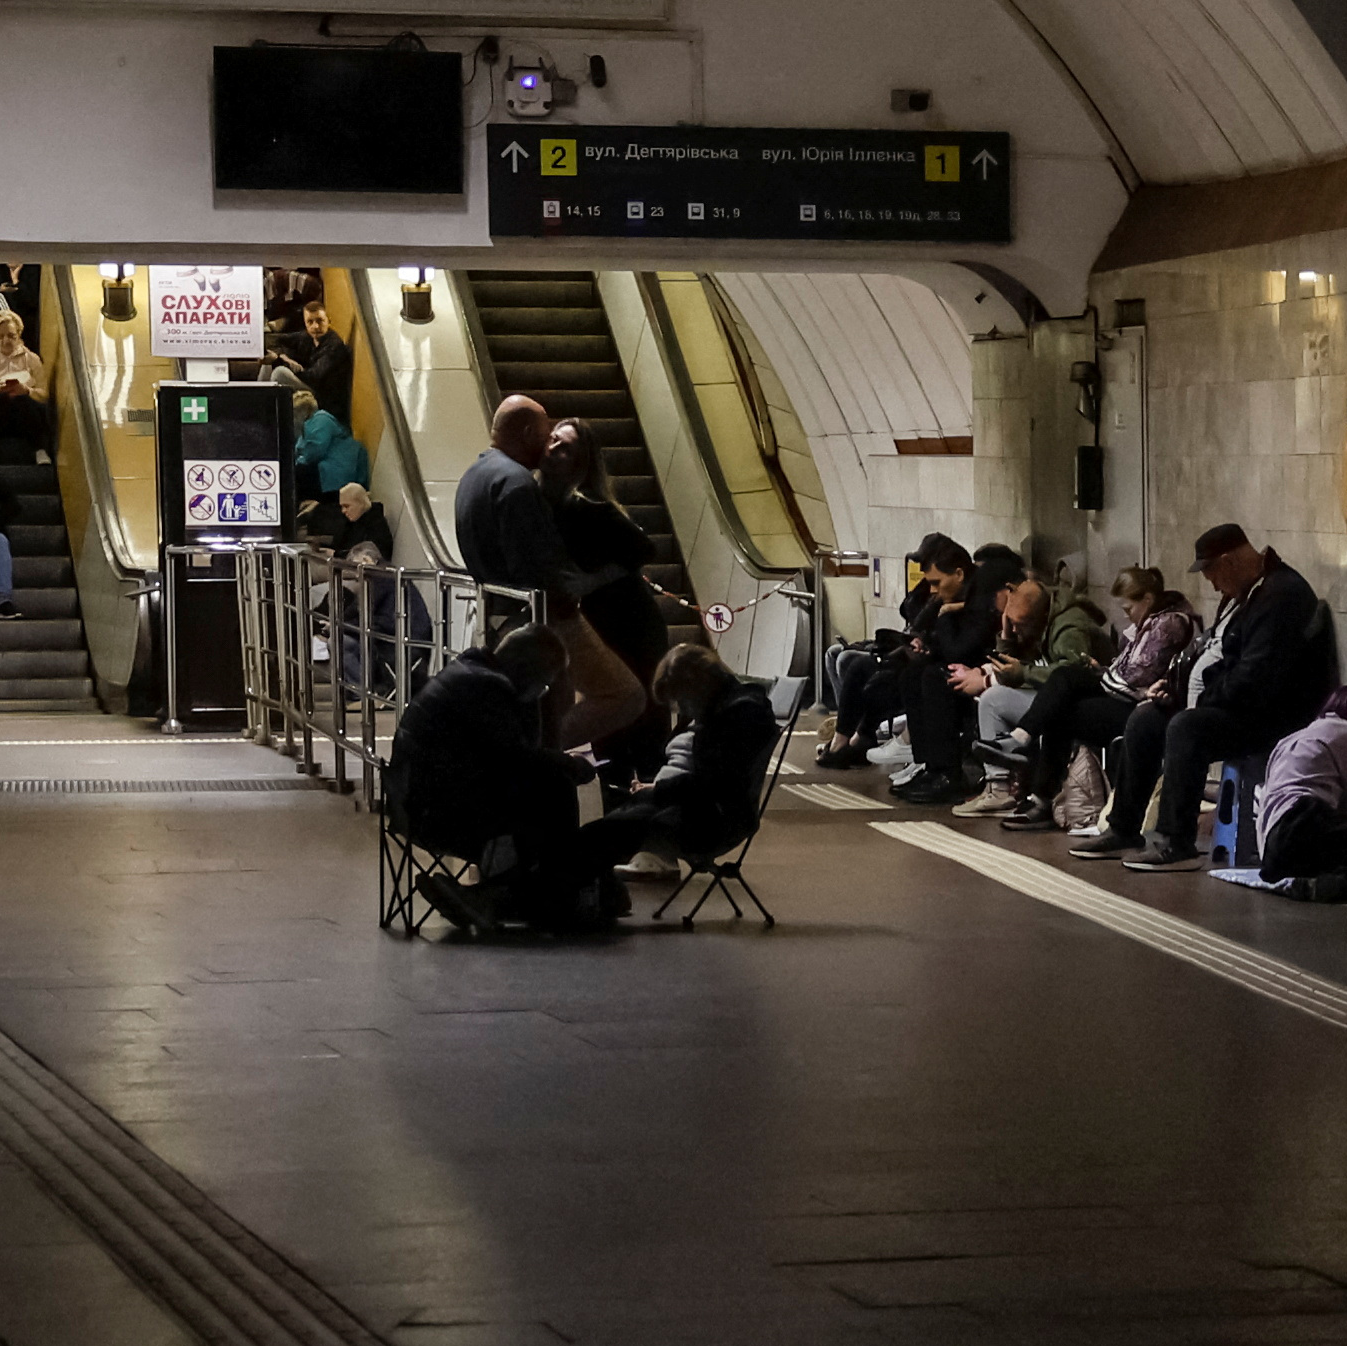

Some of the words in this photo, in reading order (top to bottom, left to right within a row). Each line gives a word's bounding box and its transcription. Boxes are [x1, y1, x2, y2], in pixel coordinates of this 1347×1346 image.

[550, 146, 567, 169] 2
[584, 144, 620, 161] вул.
[624, 142, 740, 162] Дегтярівська
[761, 148, 796, 164] вул.
[801, 146, 844, 164] Юрія
[849, 147, 916, 163] Ілленка
[935, 153, 946, 175] 1
[587, 205, 601, 217] 15
[650, 206, 665, 217] 23
[161, 294, 251, 310] СЛУХові
[161, 311, 251, 325] АПАРАТИ
